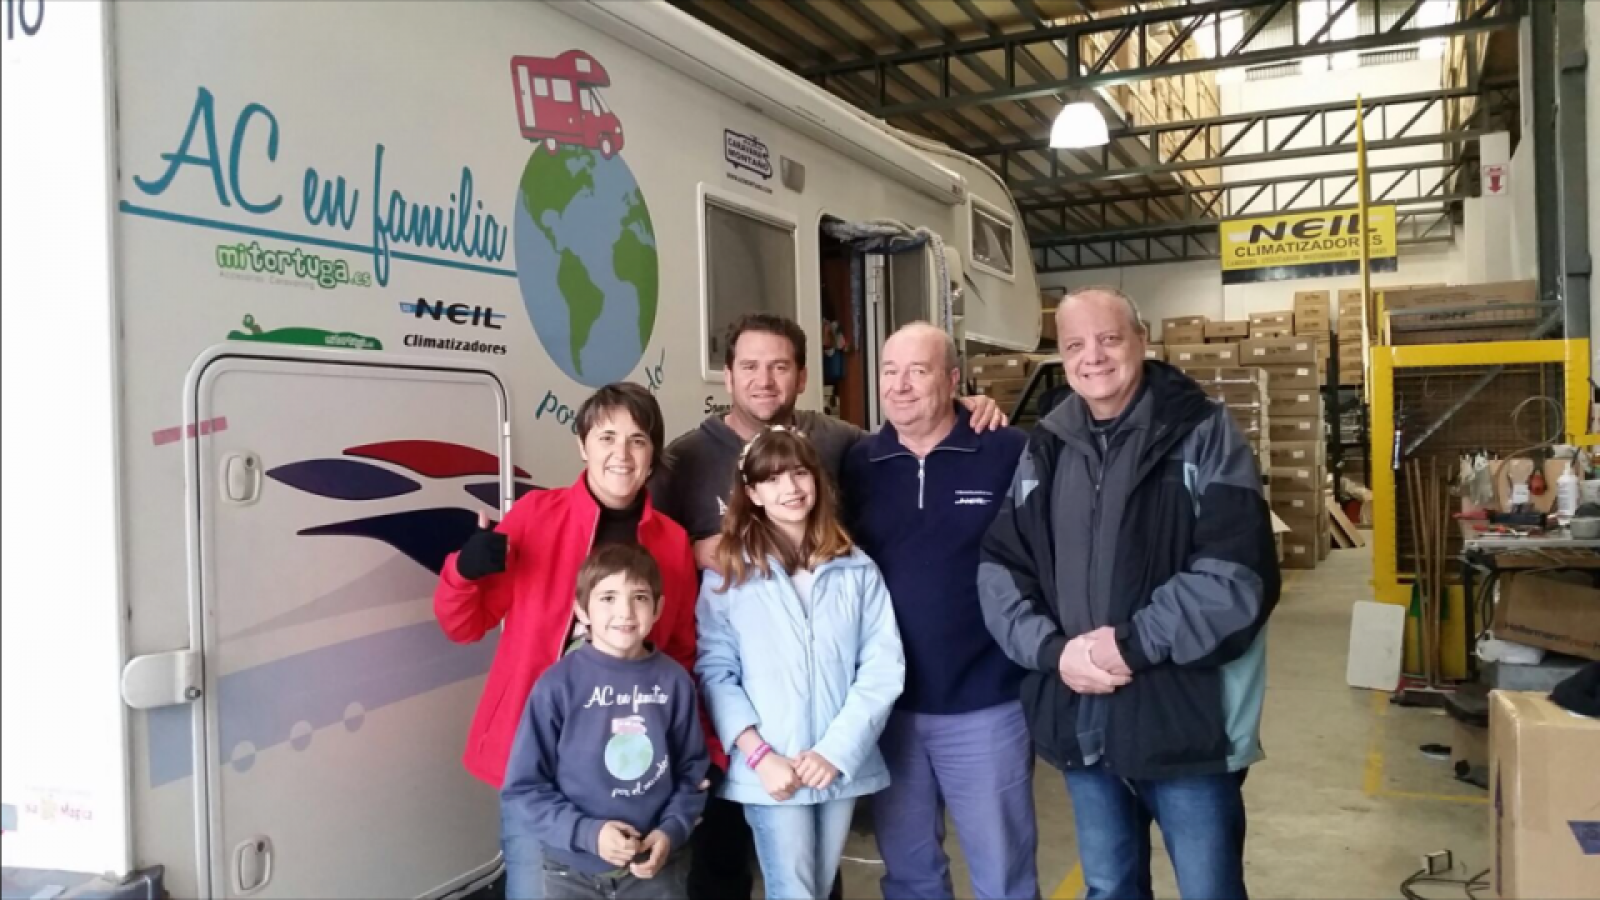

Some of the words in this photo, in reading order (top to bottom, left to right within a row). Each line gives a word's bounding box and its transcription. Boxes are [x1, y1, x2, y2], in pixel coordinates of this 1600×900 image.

[132, 86, 283, 214] AC
[303, 167, 359, 230] en
[373, 144, 507, 287] familia
[1249, 213, 1377, 244] NEIL
[1234, 234, 1383, 258] CLIMATIZADORS
[415, 297, 502, 330] NEIL
[403, 333, 508, 355] Climatizadores
[583, 684, 614, 708] AC
